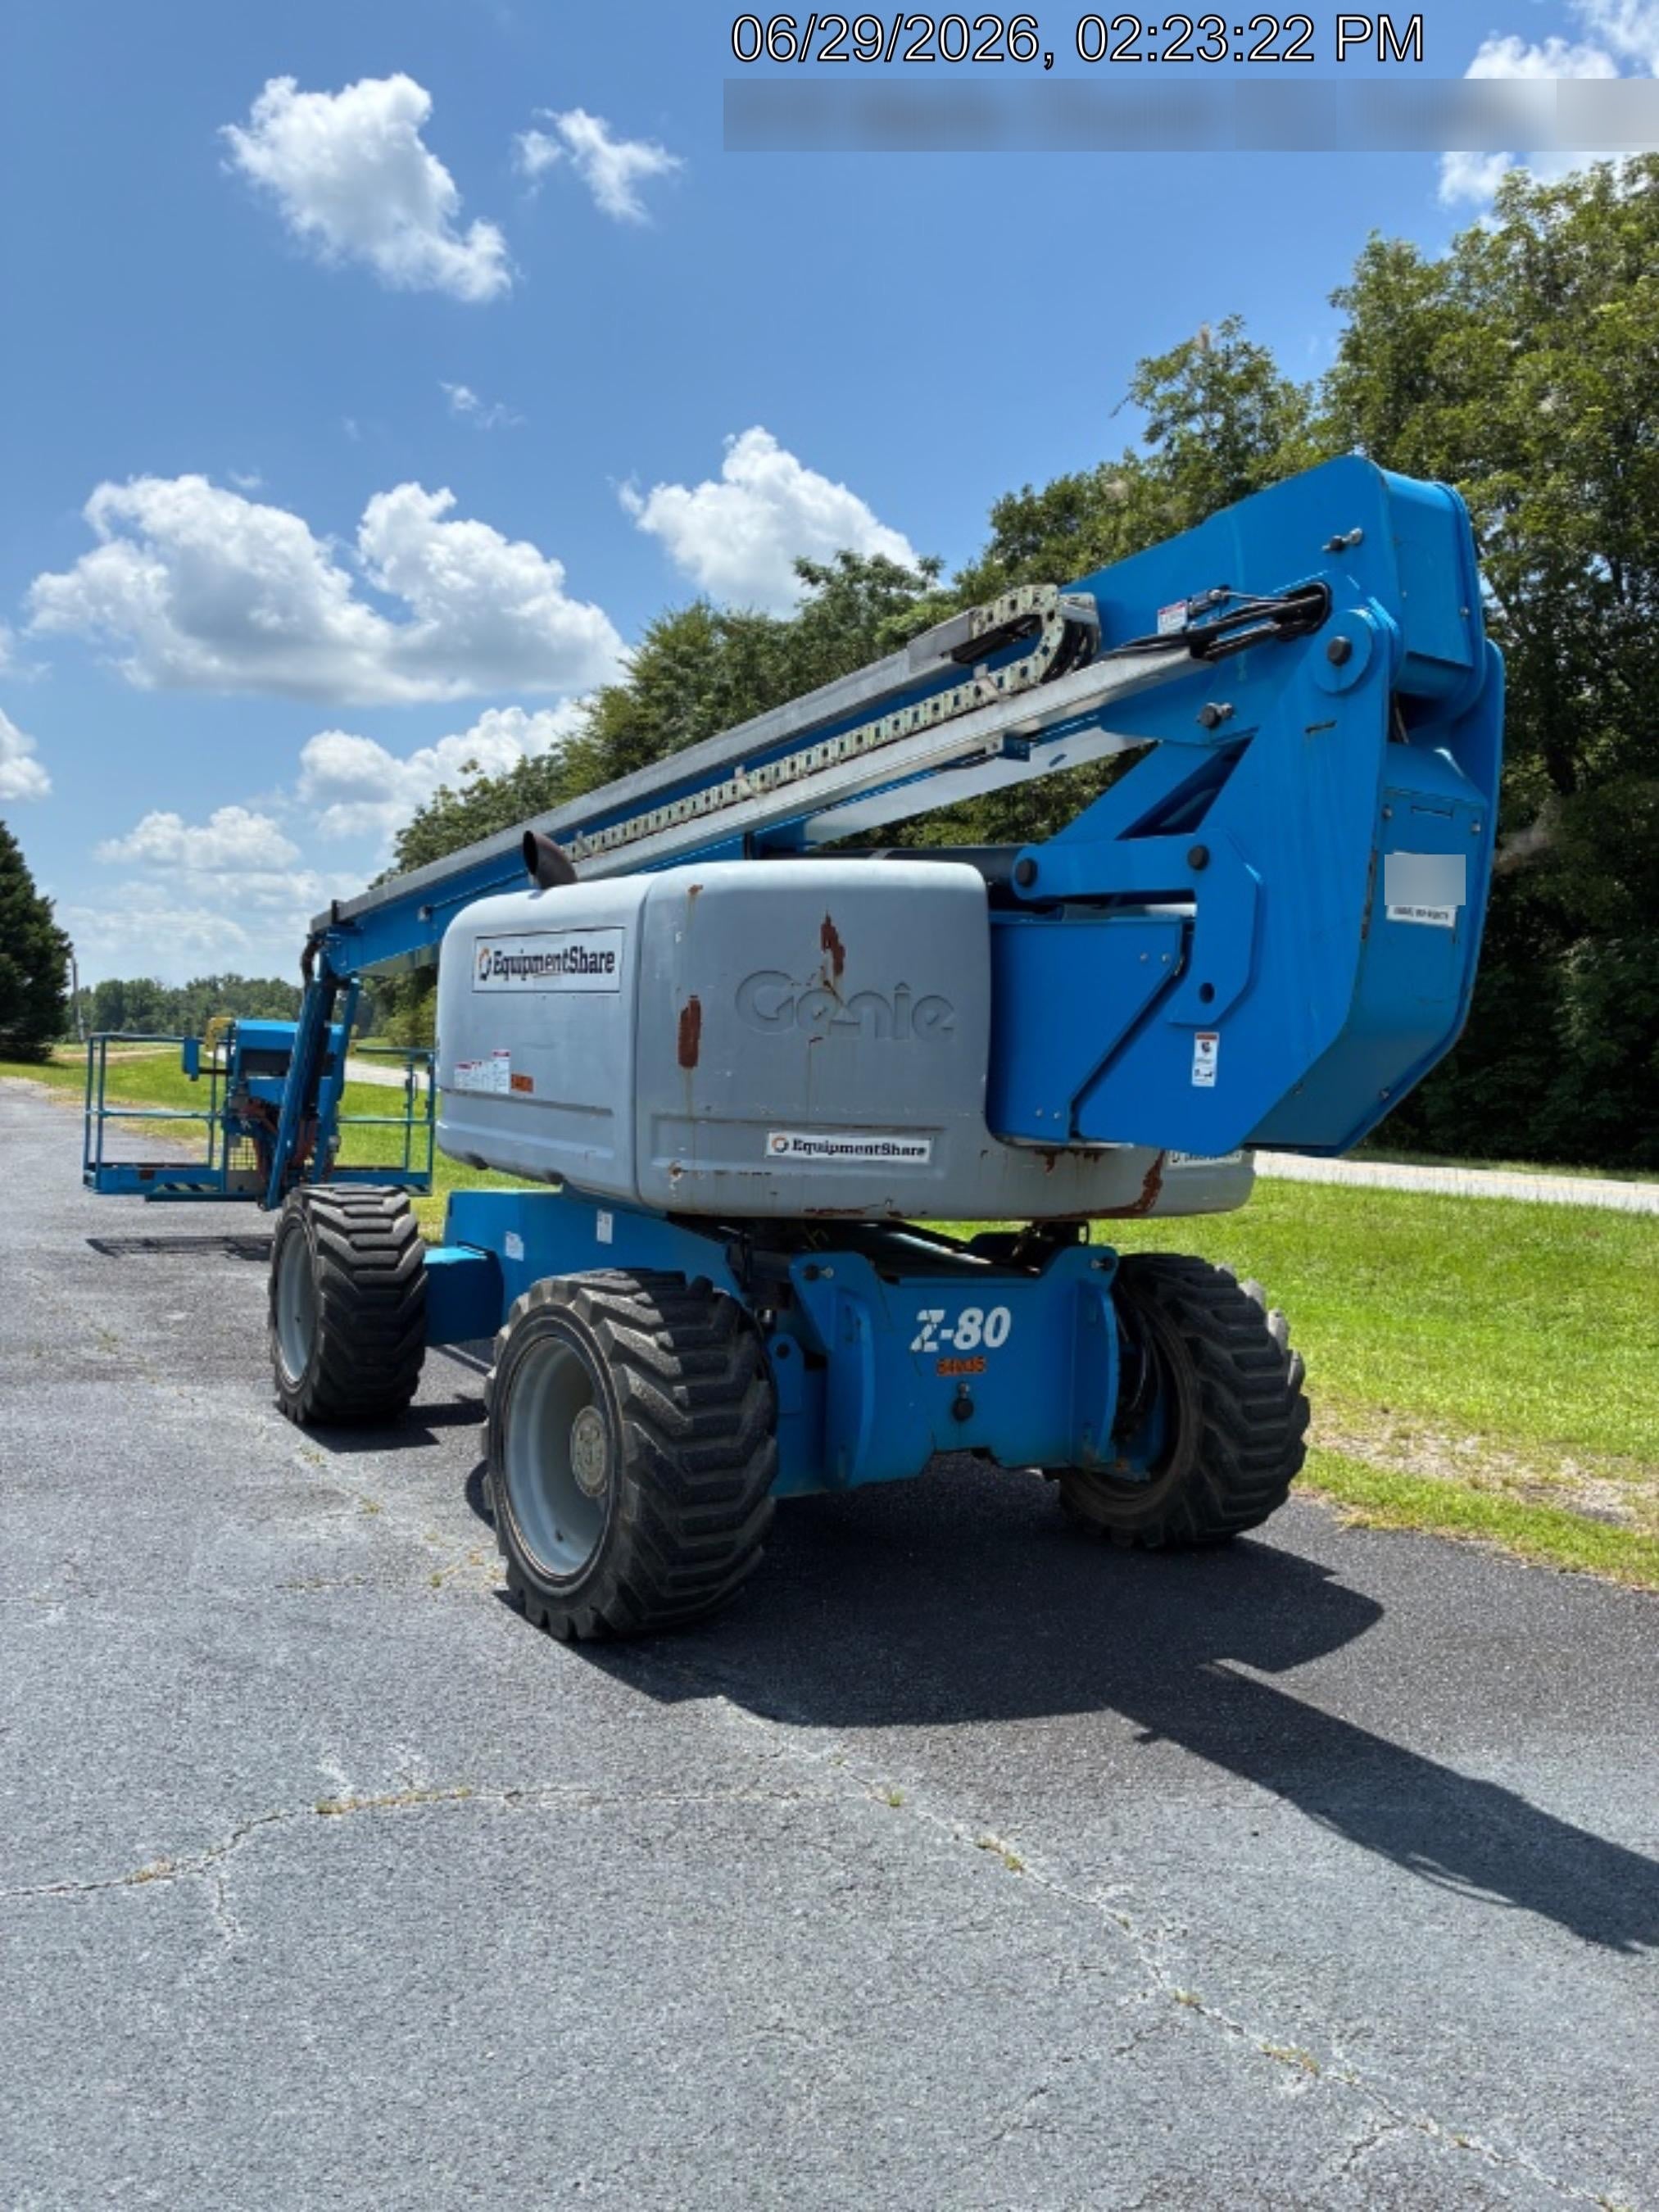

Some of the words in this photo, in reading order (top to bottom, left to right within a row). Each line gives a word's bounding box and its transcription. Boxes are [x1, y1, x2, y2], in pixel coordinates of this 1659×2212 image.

[493, 945, 614, 981] EquipmentShare
[736, 970, 955, 1042] Genie
[792, 1138, 926, 1156] EquipmentShare
[910, 1305, 1012, 1352] Z-80
